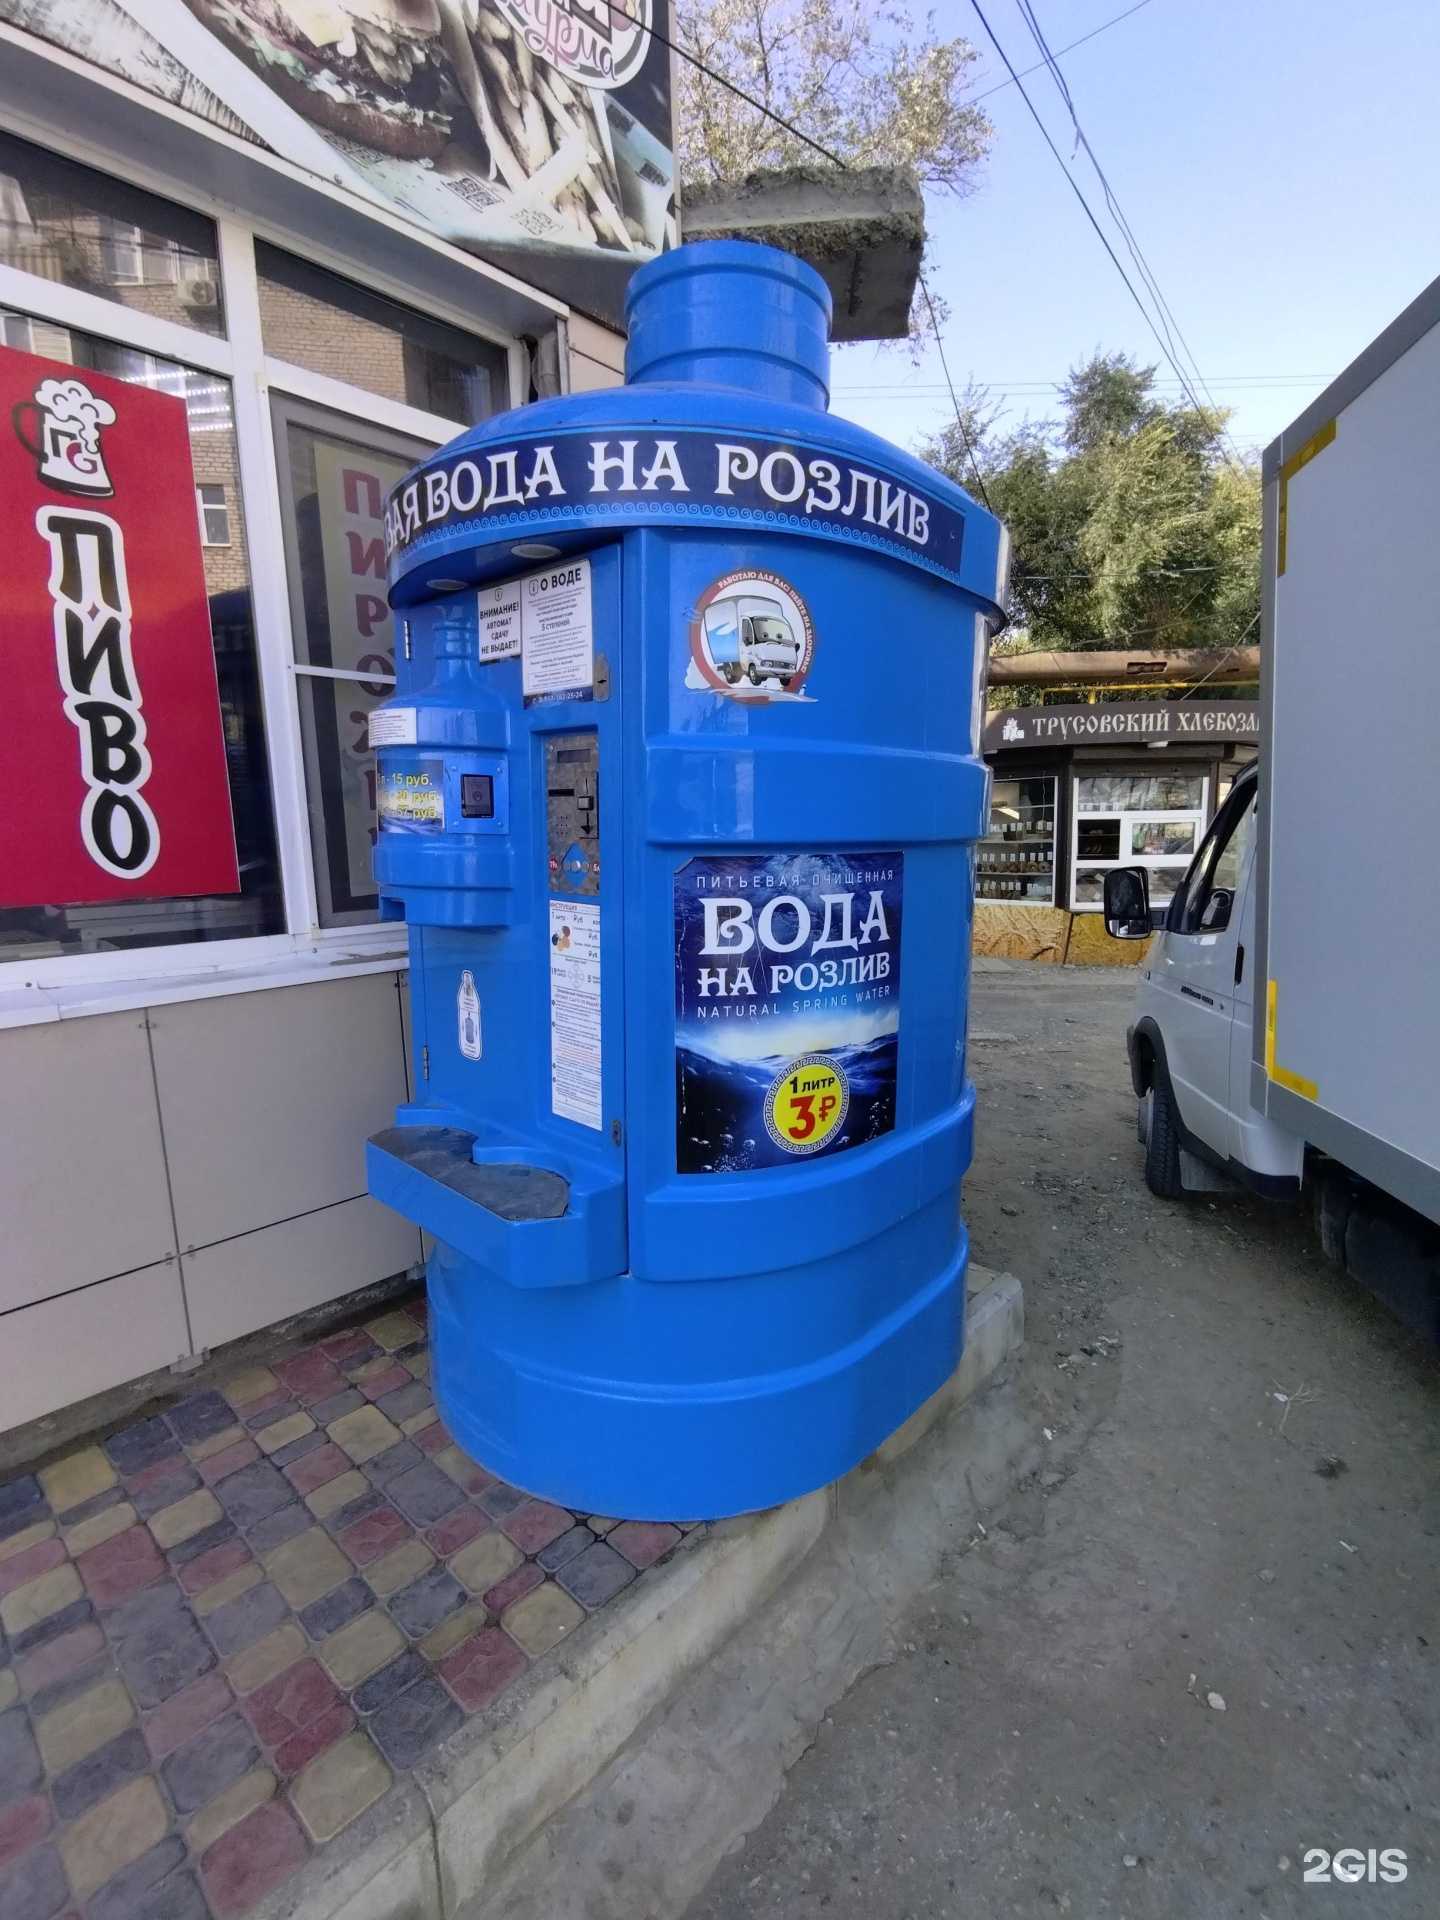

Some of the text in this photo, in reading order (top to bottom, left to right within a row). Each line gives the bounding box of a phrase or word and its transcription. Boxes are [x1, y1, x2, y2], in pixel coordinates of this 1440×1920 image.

[424, 446, 567, 522] ВОДА
[588, 440, 691, 492] НА
[713, 443, 930, 545] РОЗЛИВ
[540, 568, 582, 592] О ВОДЕ
[480, 600, 519, 620] ВНИМАНИЕ!
[487, 617, 512, 630] АВТОМАТ
[491, 630, 509, 641] СДАЧУ
[481, 639, 518, 655] НЕ ВЫДАЕТ!
[46, 514, 150, 872] ПИВО
[1032, 709, 1260, 739] ТРУСОВСКИЙ ХЛЕБОЗА
[391, 772, 403, 785] 15
[406, 773, 433, 788] руб.
[697, 869, 894, 889] ПИТЬЕВАЯ ОЧИЩЕННАЯ
[698, 890, 890, 957] ВОДА
[697, 952, 890, 997] НА РОЗЛИВ
[697, 985, 890, 1018] NATURAL SPRING WATER
[789, 1076, 798, 1093] 1
